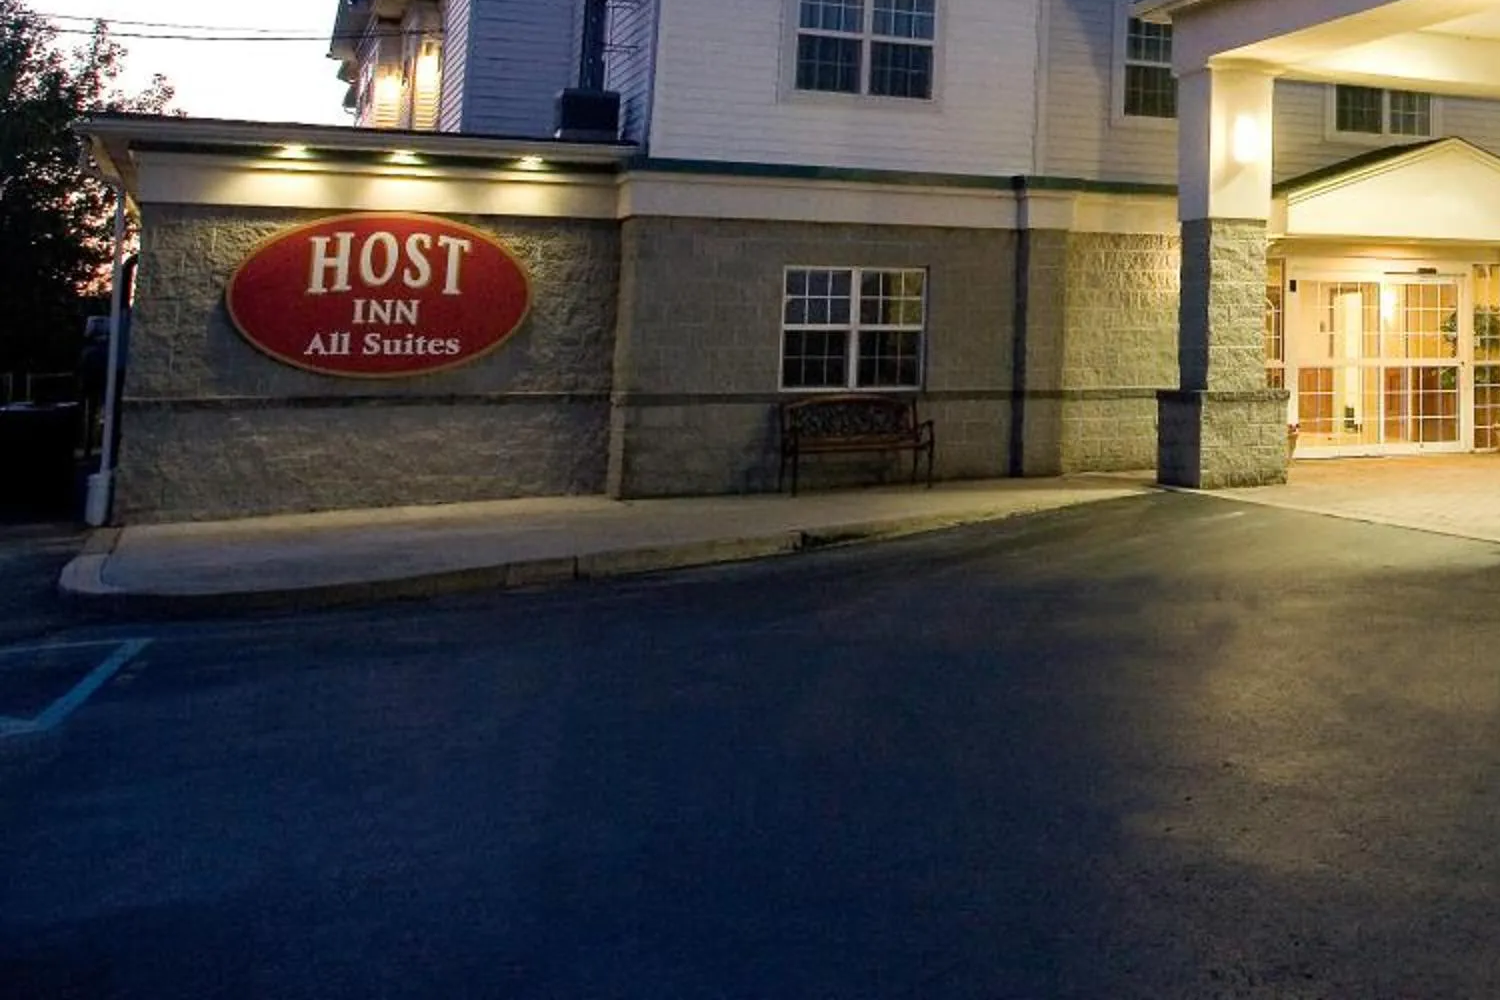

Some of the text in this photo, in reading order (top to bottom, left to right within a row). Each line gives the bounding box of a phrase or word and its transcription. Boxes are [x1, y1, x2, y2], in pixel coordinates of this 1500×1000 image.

[307, 231, 472, 295] HOST
[352, 299, 419, 325] INN
[304, 332, 460, 355] All Suites
